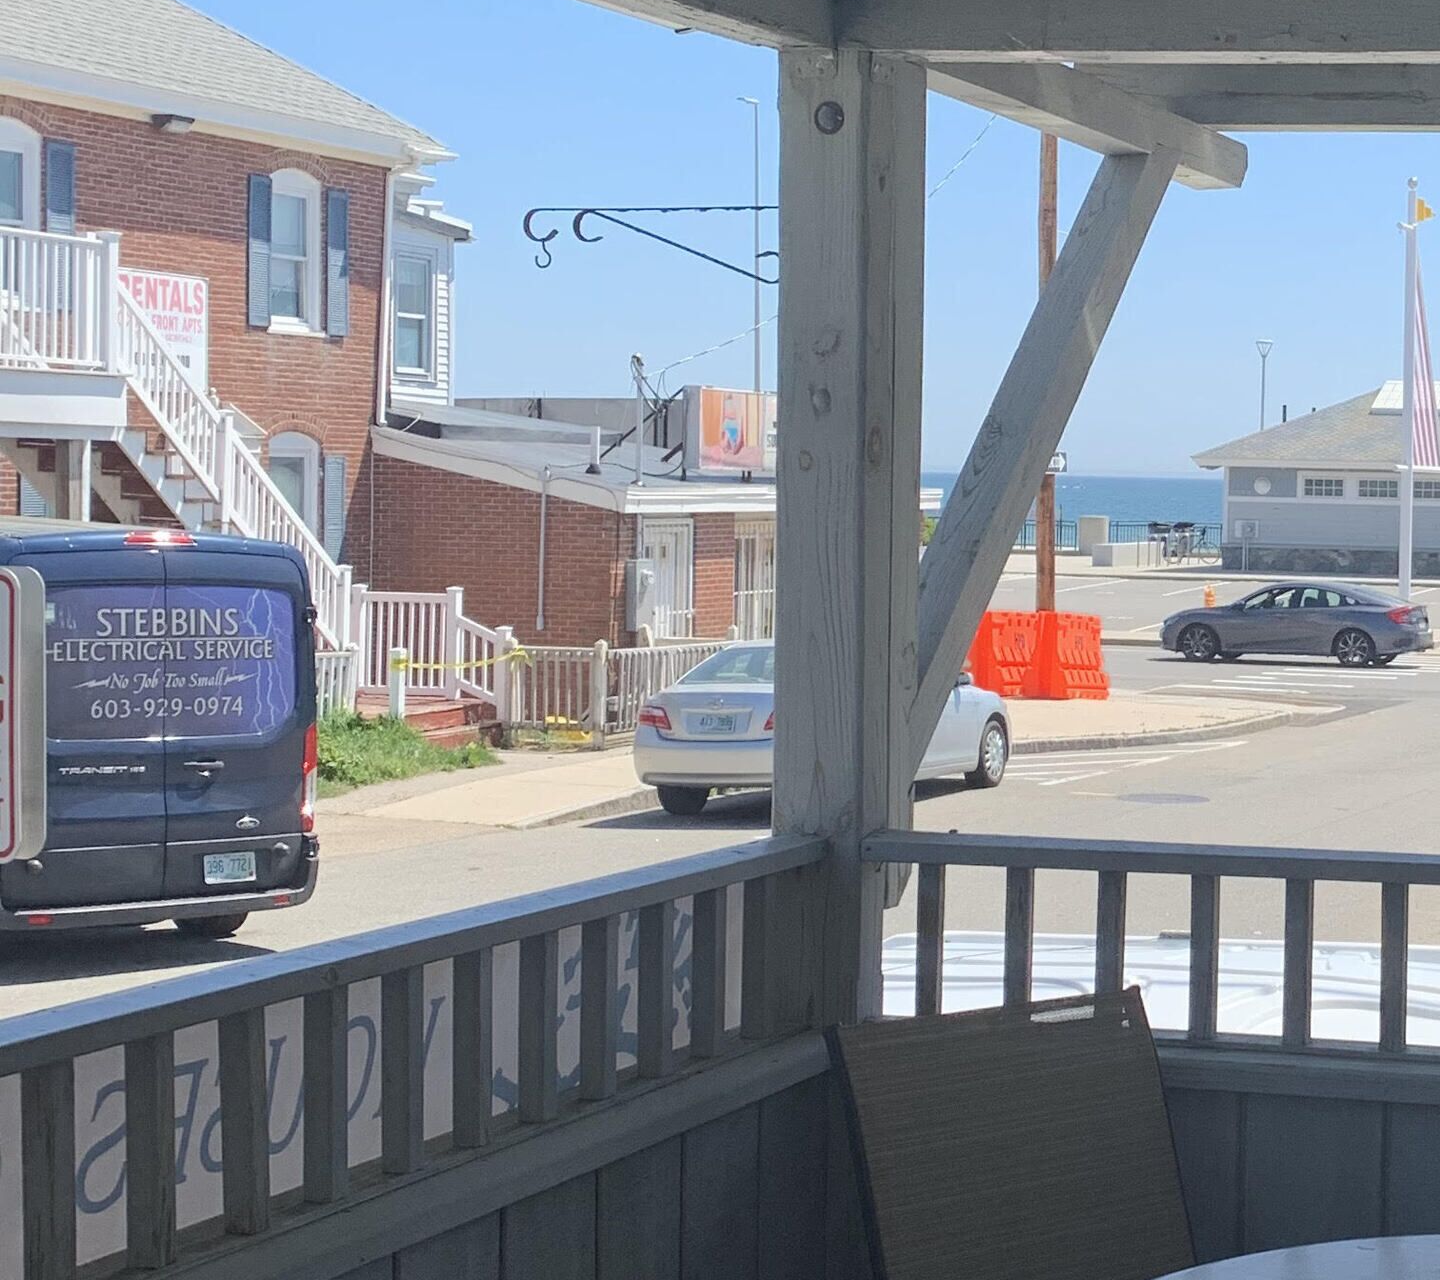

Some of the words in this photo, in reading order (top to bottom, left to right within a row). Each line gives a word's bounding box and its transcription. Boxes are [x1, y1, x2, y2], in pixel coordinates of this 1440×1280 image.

[96, 608, 239, 637] STEBBINS
[53, 640, 187, 662] ELECTRICAL
[193, 639, 274, 660] SERVICE
[109, 672, 129, 689] No
[133, 668, 161, 694] Job
[164, 672, 186, 689] Too
[190, 667, 227, 689] Small
[91, 695, 244, 719] 603-929-0974
[58, 765, 129, 776] TRANSIT
